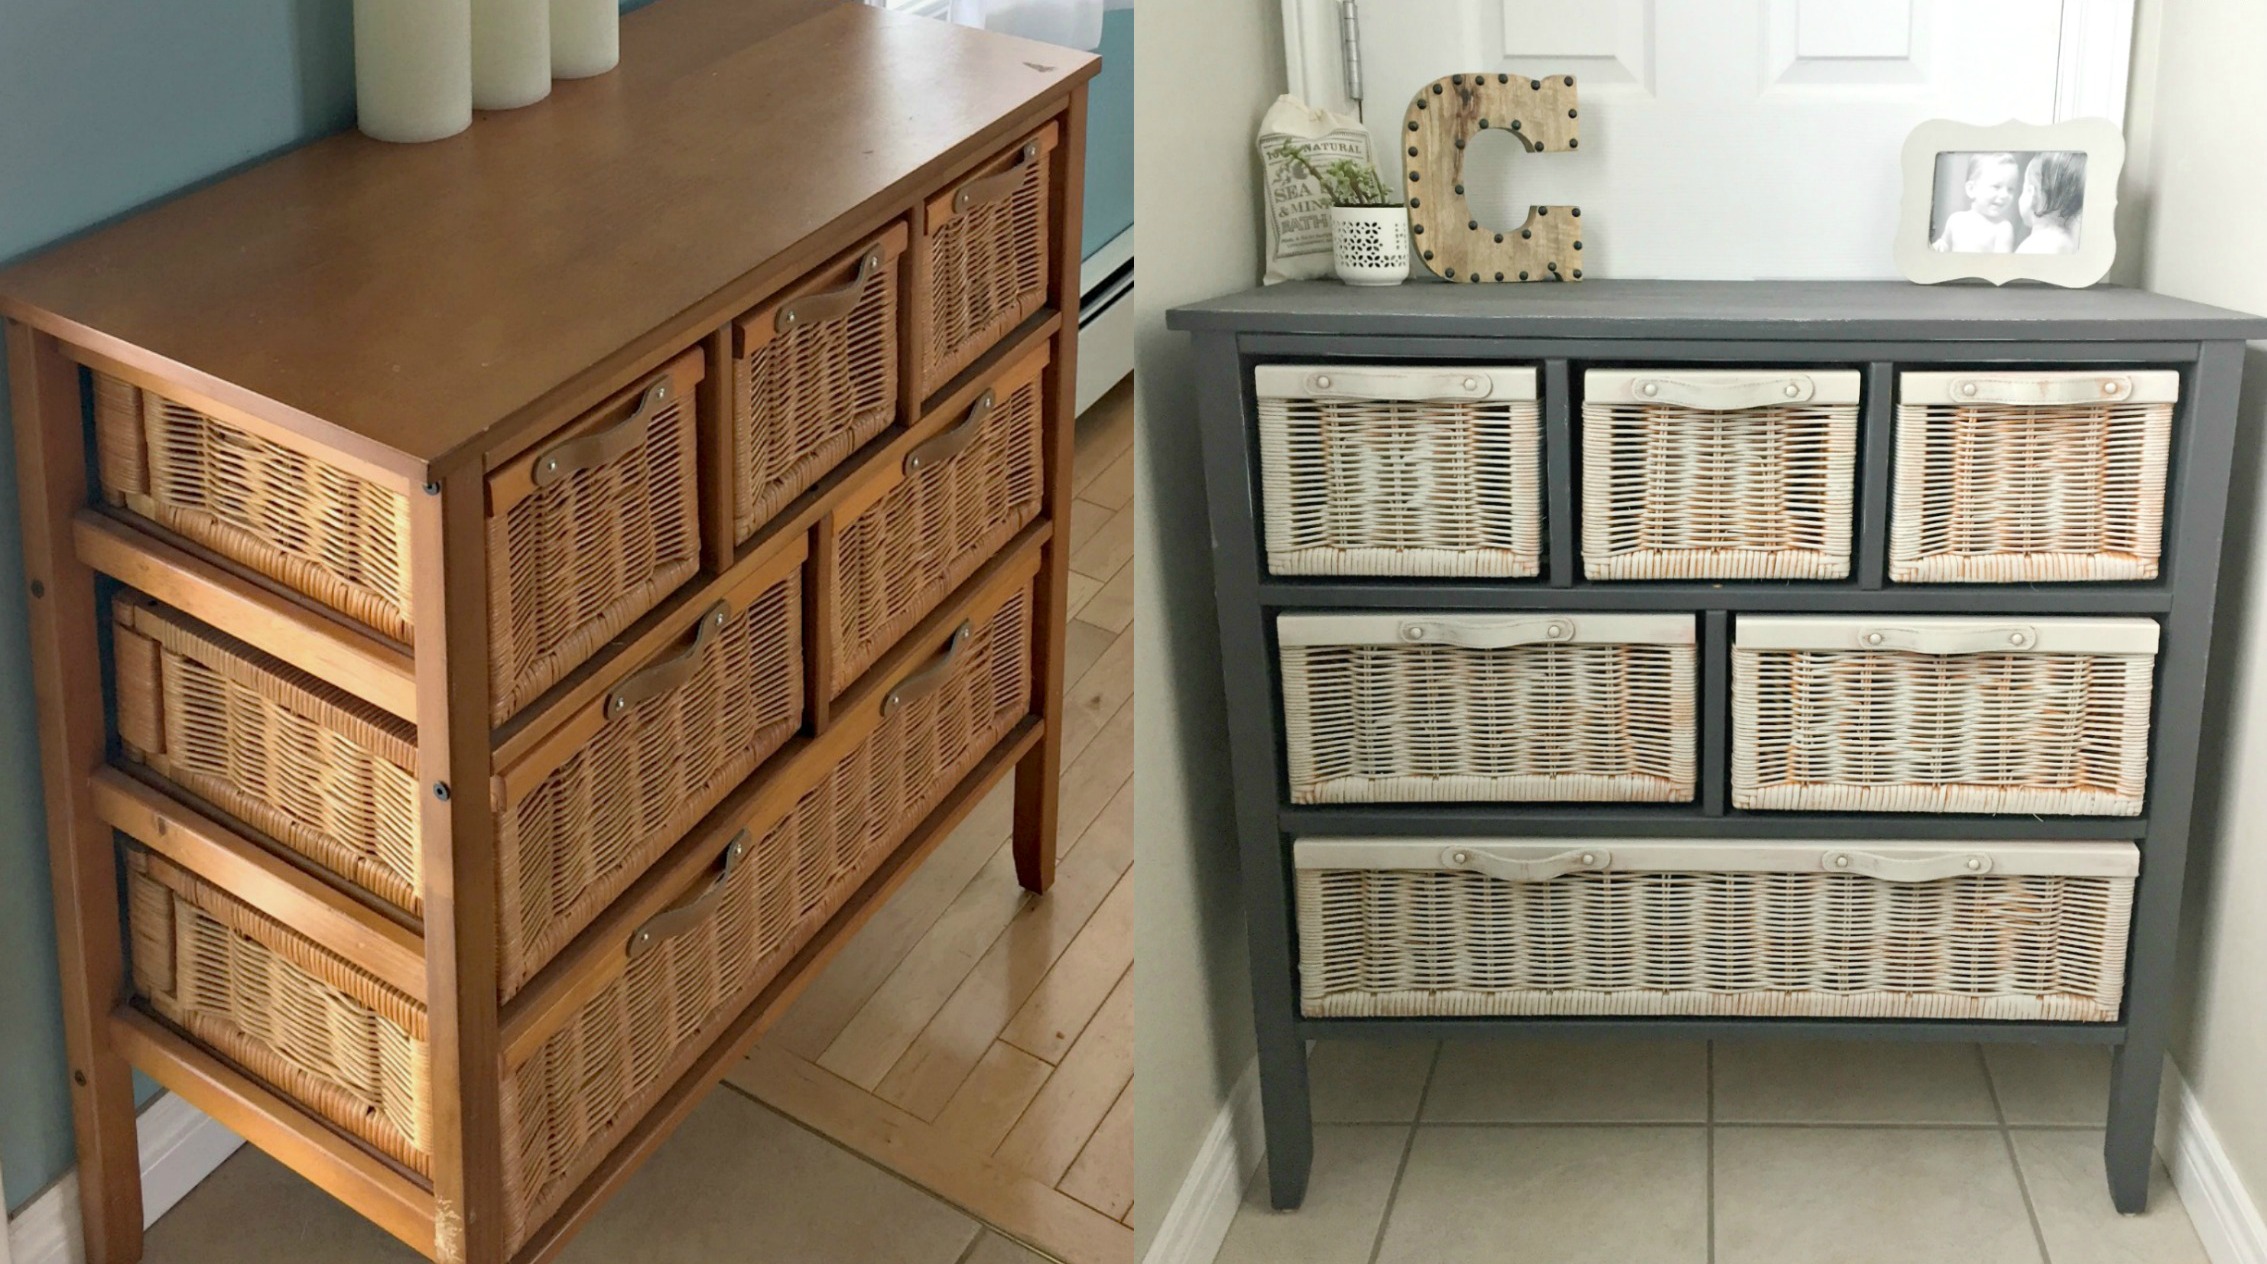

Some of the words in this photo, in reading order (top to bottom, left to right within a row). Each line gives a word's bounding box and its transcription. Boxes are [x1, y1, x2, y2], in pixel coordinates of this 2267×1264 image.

[1303, 142, 1362, 154] NATURAL
[1402, 73, 1583, 282] C
[1274, 183, 1313, 203] SEA
[1278, 206, 1290, 218] &
[1281, 213, 1329, 234] BATH
